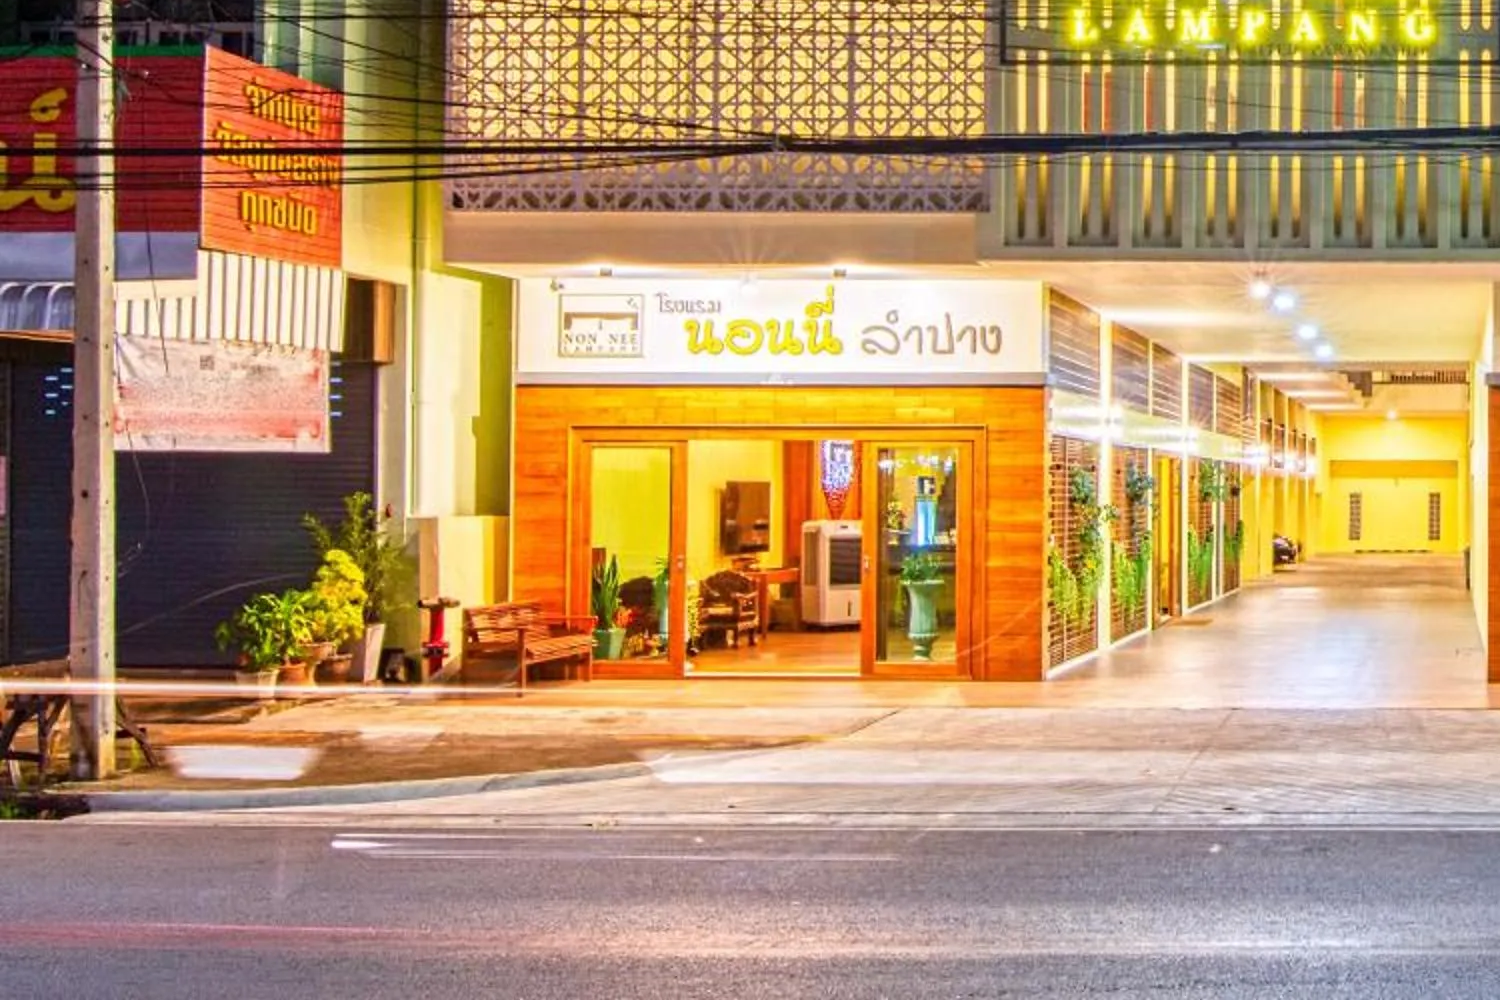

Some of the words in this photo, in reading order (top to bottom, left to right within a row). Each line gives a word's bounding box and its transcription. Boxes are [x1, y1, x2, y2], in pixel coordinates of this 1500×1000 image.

[1071, 9, 1437, 42] LAMPANG
[655, 292, 722, 314] โรงแรม
[684, 284, 844, 356] นอนนี่
[861, 309, 1003, 355] ลำปาง
[563, 333, 597, 345] NON
[608, 333, 638, 345] NEE
